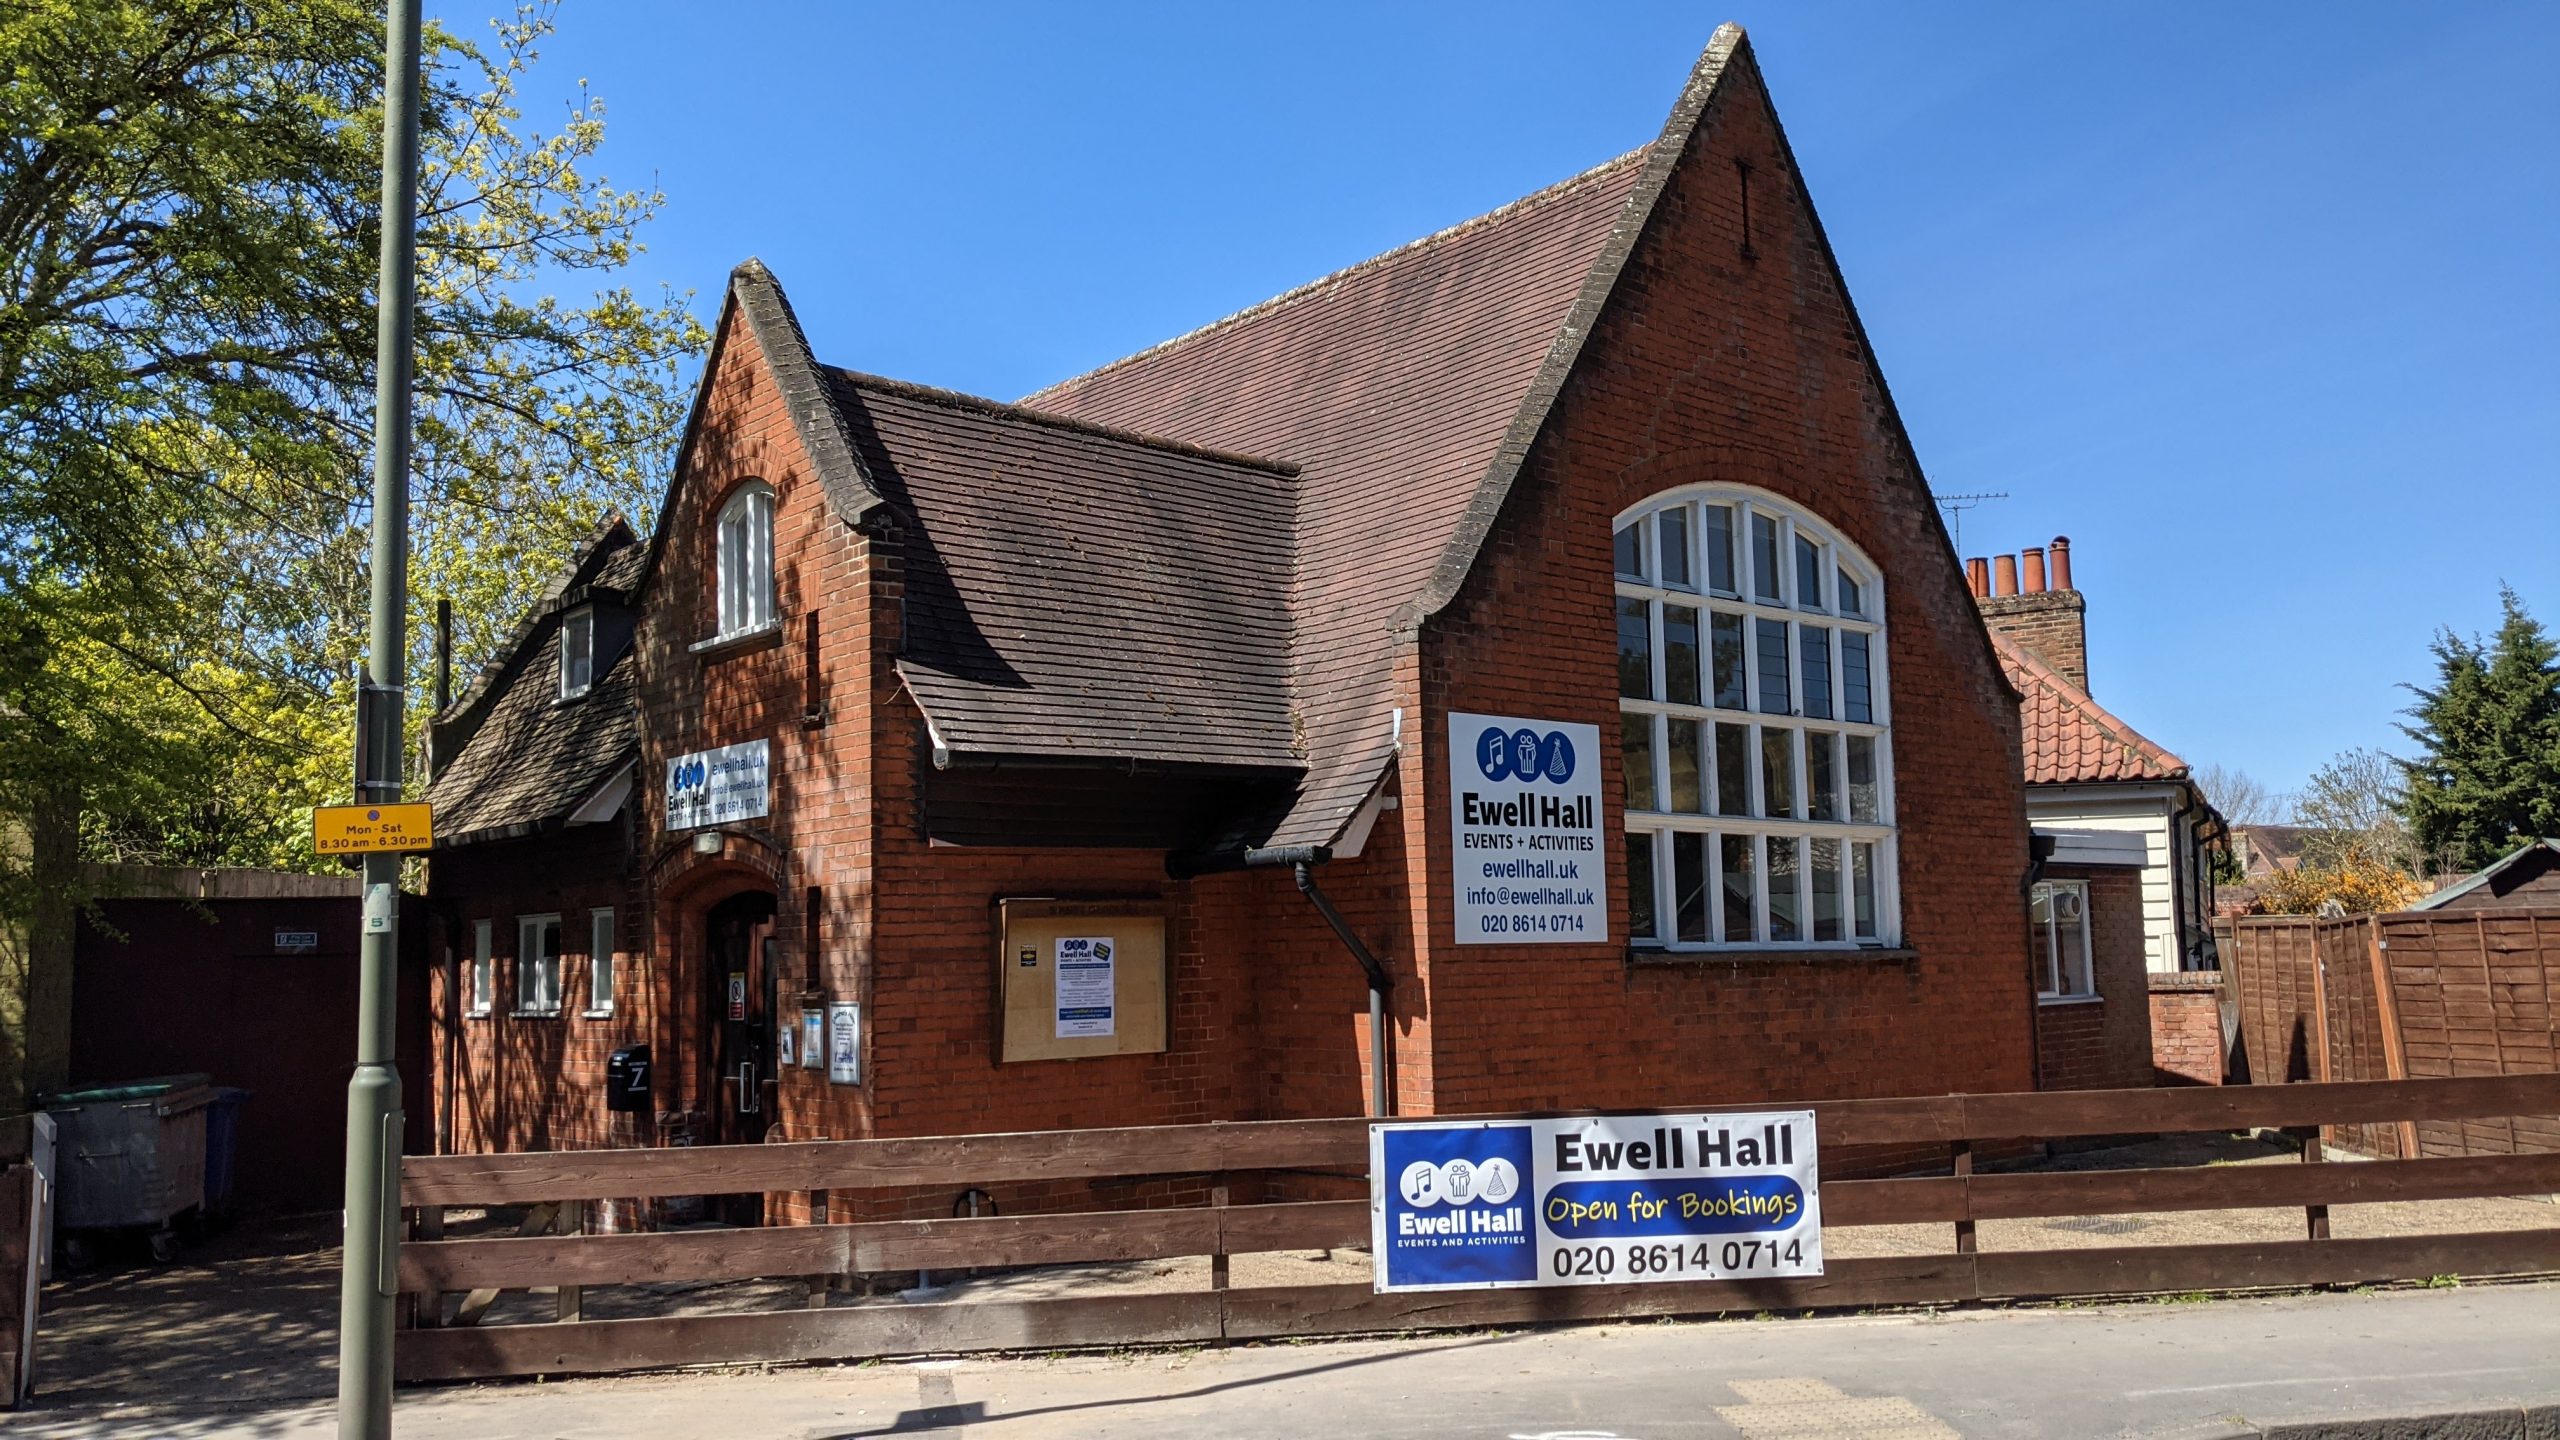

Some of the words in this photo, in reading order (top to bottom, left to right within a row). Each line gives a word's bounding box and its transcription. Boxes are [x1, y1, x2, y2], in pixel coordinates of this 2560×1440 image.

[712, 753, 765, 775] ewellhall.uk
[712, 777, 765, 795] info@ewellhall.uk
[668, 790, 691, 812] Ewell
[692, 787, 711, 807] Hall
[714, 803, 726, 815] 020
[727, 800, 743, 813] 8614
[745, 797, 763, 810] 0714
[1462, 792, 1536, 827] Ewell
[1541, 795, 1593, 829] Hall
[346, 825, 371, 834] Mon
[382, 824, 402, 833] Sat
[320, 839, 349, 849] 8.30
[352, 840, 369, 848] am
[379, 836, 407, 846] 6.30
[410, 837, 428, 846] pm
[1464, 833, 1513, 850] EVENTS
[1517, 837, 1525, 847] +
[1528, 835, 1594, 851] ACTIVITIES
[1482, 859, 1579, 879] ewellhall.uk
[1467, 887, 1594, 906] info@ewellhall.uk
[371, 918, 384, 928] 5
[1481, 915, 1508, 933] 020
[1512, 914, 1547, 932] 8614
[1551, 914, 1584, 932] 0714
[1060, 950, 1077, 958] Ewell
[1078, 950, 1092, 958] Hall
[631, 1067, 644, 1087] 7
[1555, 1127, 1685, 1172] Ewell
[1697, 1124, 1793, 1168] Hall
[1548, 1197, 1618, 1228] Open
[1627, 1191, 1668, 1223] for
[1677, 1188, 1798, 1224] Bookings
[1399, 1209, 1467, 1235] Ewell
[1471, 1207, 1523, 1233] Hall
[1398, 1238, 1438, 1248] EVENTS
[1442, 1237, 1463, 1247] AND
[1467, 1235, 1526, 1246] ACTIVITIES
[1553, 1246, 1615, 1278] 020
[1628, 1242, 1710, 1274] 8614
[1722, 1238, 1804, 1271] 0714
